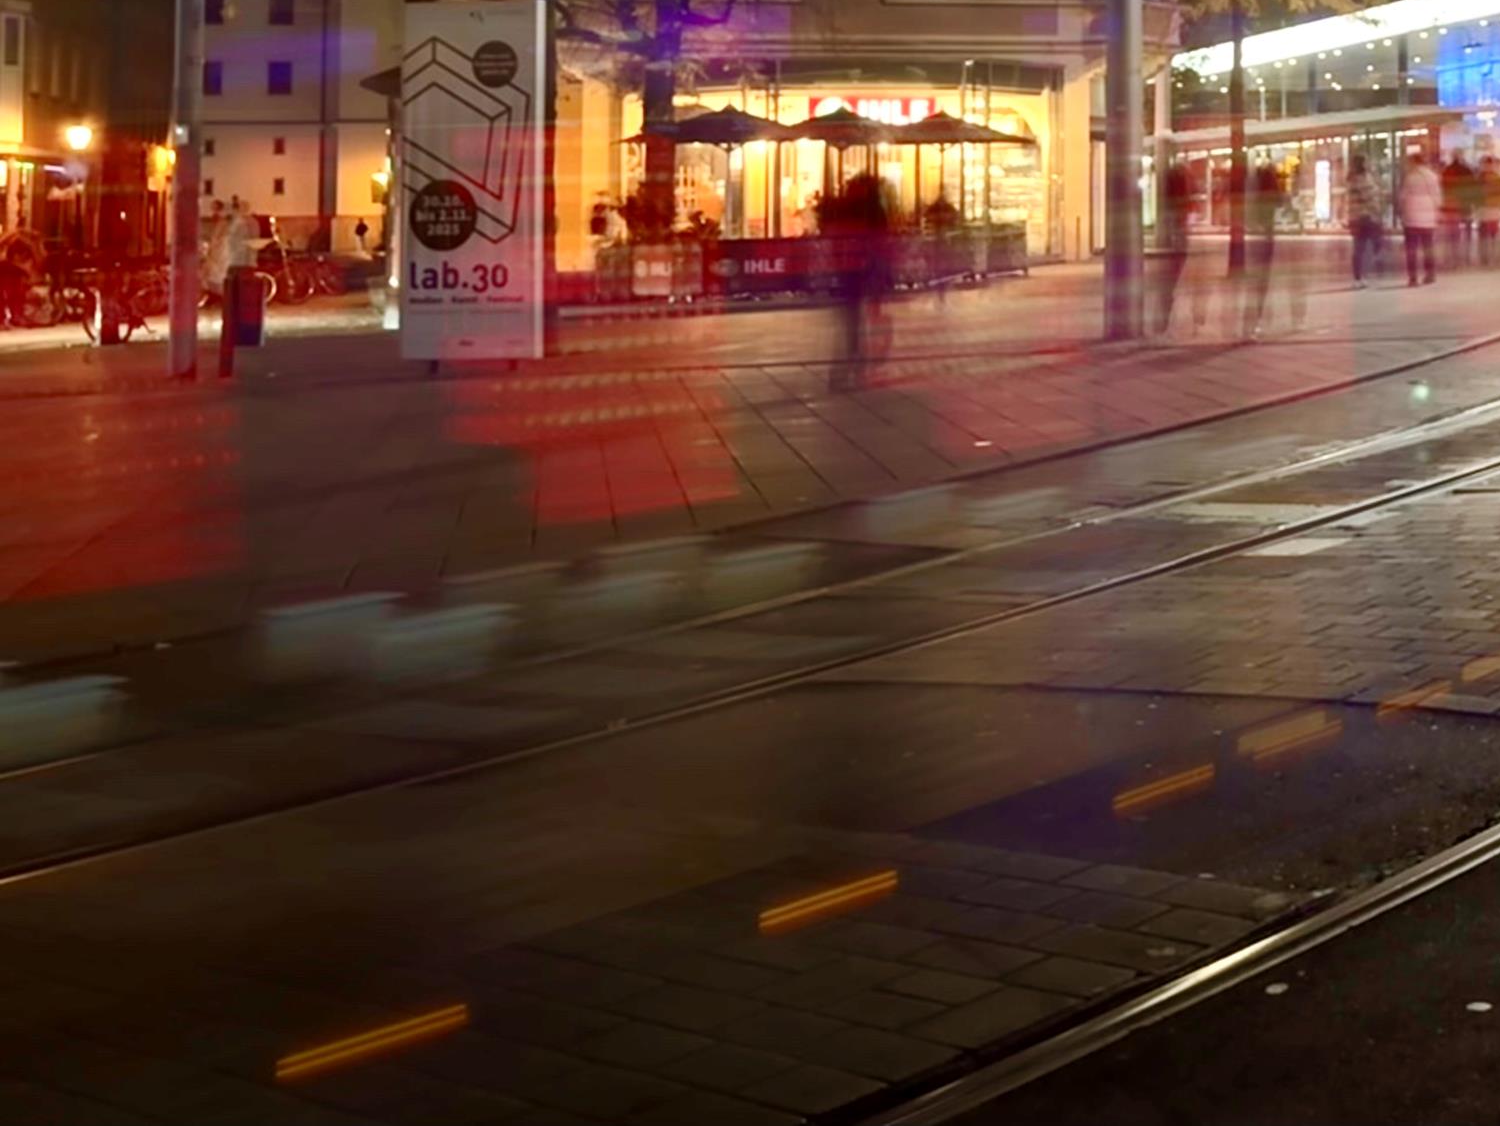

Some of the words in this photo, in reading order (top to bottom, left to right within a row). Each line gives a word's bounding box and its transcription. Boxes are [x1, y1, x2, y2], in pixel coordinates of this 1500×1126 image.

[857, 98, 929, 126] IHLE
[410, 260, 509, 293] lab.30
[744, 258, 786, 274] IHLE
